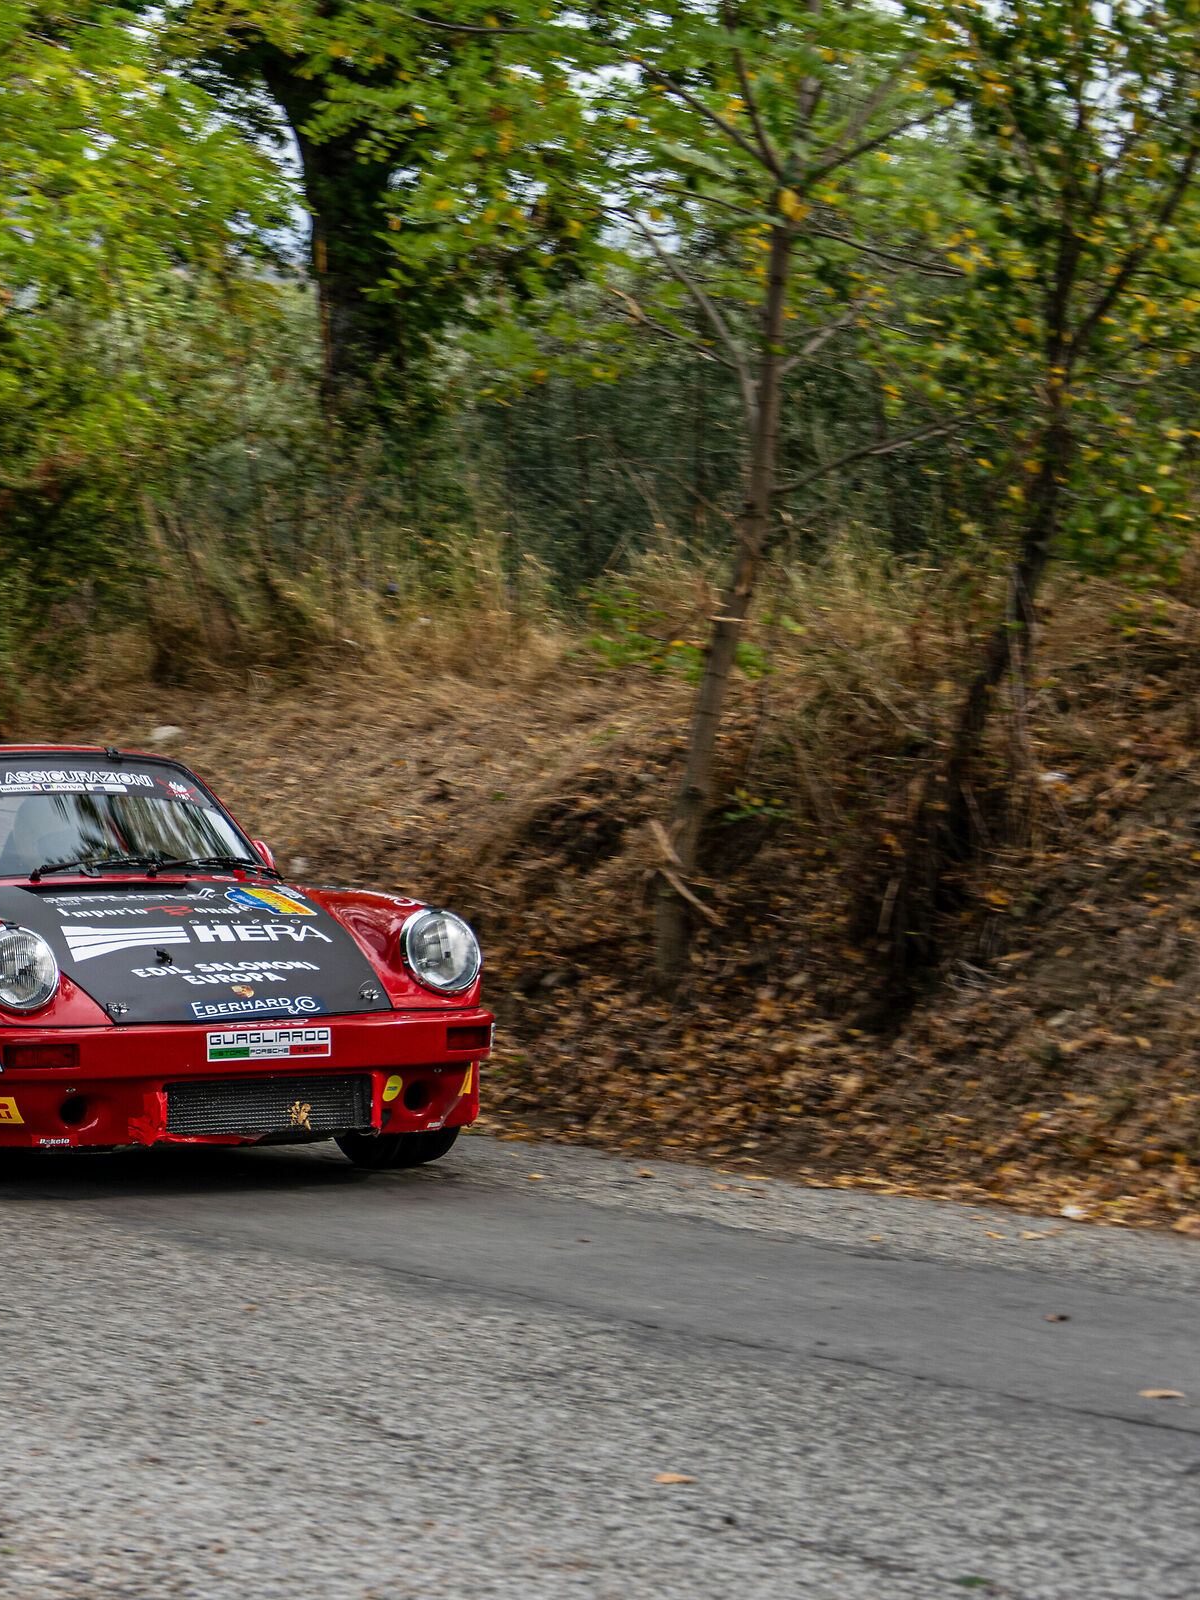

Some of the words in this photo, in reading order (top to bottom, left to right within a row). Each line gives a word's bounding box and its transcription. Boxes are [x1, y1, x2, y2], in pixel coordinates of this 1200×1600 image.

[5, 771, 154, 787] ASSICURAZIONI
[192, 924, 333, 943] HERA
[131, 965, 192, 978] EDIL
[194, 960, 320, 973] SALOMONI
[182, 971, 287, 985] EUROPA
[210, 1029, 329, 1047] GUAGLIARDO
[250, 1047, 289, 1056] PORSCHE
